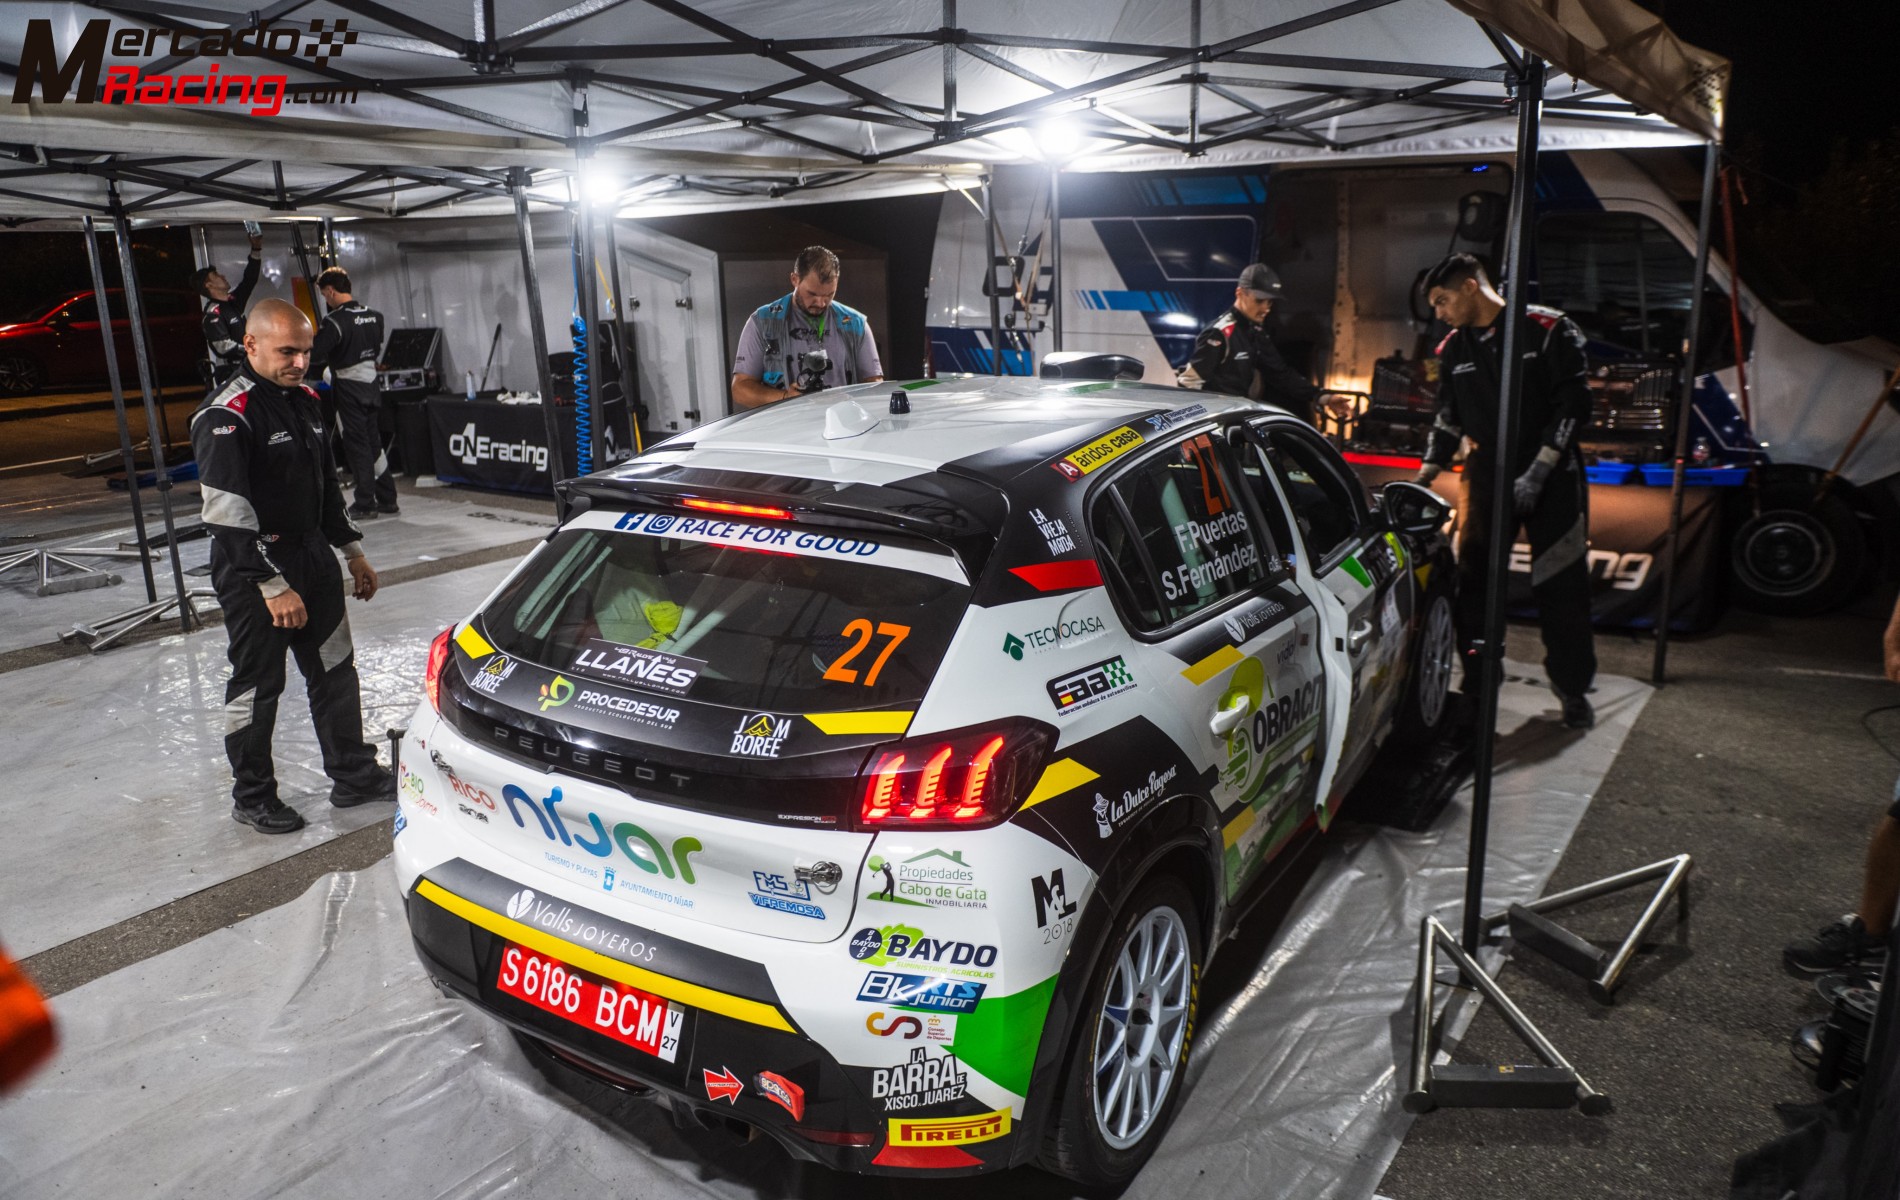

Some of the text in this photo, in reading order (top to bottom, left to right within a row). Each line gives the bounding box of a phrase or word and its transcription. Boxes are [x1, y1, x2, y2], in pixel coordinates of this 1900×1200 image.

[1109, 430, 1140, 449] casa
[1181, 433, 1232, 516] 27
[676, 517, 880, 557] RACE FOR GOOD
[1174, 511, 1248, 553] F.Puertas
[1162, 544, 1258, 600] S.Fernández
[1024, 616, 1106, 649] TECNOCASA
[822, 618, 911, 687] 27
[575, 649, 697, 688] LLANES
[577, 690, 680, 723] PROCEDESUR
[493, 726, 691, 788] PEUGEOT
[729, 734, 784, 758] BOREE
[1111, 801, 1125, 822] La
[1123, 788, 1150, 813] Dulce
[544, 852, 571, 868] TURISMO
[576, 864, 598, 879] PLAYAS
[899, 864, 974, 881] Propiedades
[620, 880, 673, 903] AYUNTAMIENTO
[899, 882, 988, 901] Cabo de Gata
[925, 898, 988, 909] INMOBILIARIA
[533, 900, 657, 963] Valls JOYEROS
[1043, 917, 1073, 945] 2018
[886, 934, 998, 968] BAYDO
[896, 961, 996, 979] SUMINISTROS AGRICOLAS
[502, 949, 663, 1047] S 6186 BCM
[669, 1012, 680, 1028] V
[661, 1035, 678, 1052] 27
[910, 1048, 925, 1065] LA
[872, 1055, 966, 1099] BARRA DE
[884, 1095, 919, 1111] XISCO
[922, 1085, 966, 1106] JUAREZ
[900, 1115, 1003, 1142] PIRELLI
